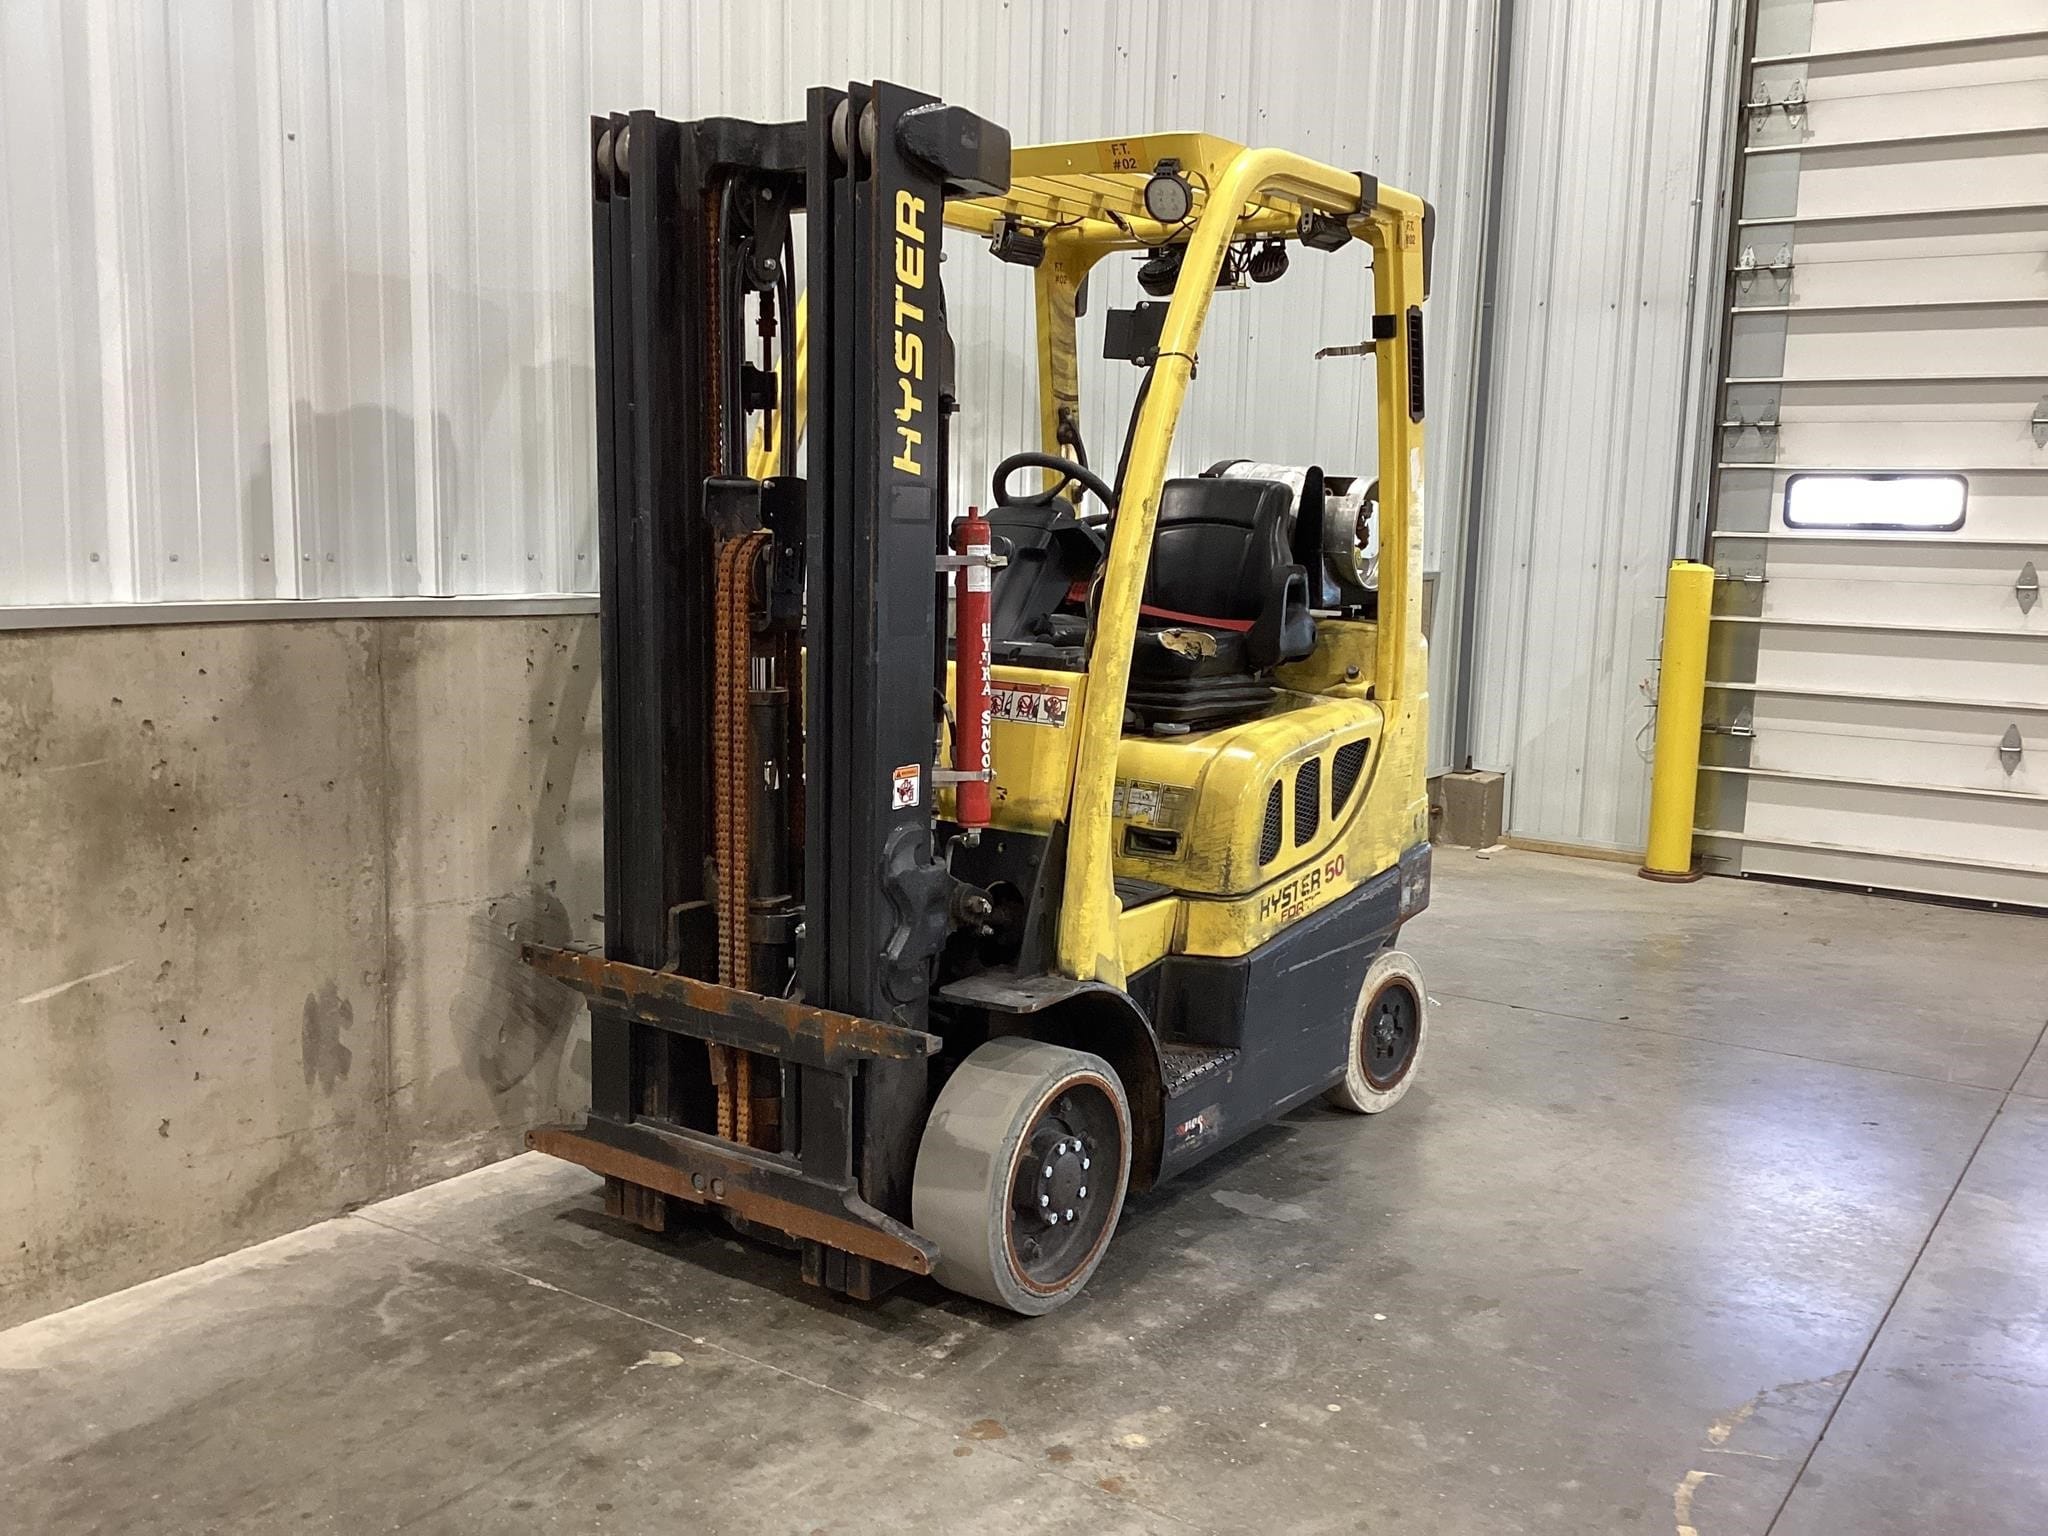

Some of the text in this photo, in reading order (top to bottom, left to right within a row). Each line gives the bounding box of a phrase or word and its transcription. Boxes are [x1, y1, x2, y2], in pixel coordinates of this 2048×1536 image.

[1111, 142, 1130, 156] F.T.
[1112, 158, 1137, 171] #02
[893, 190, 925, 476] HYSTER
[1260, 854, 1344, 922] HYSTER 50
